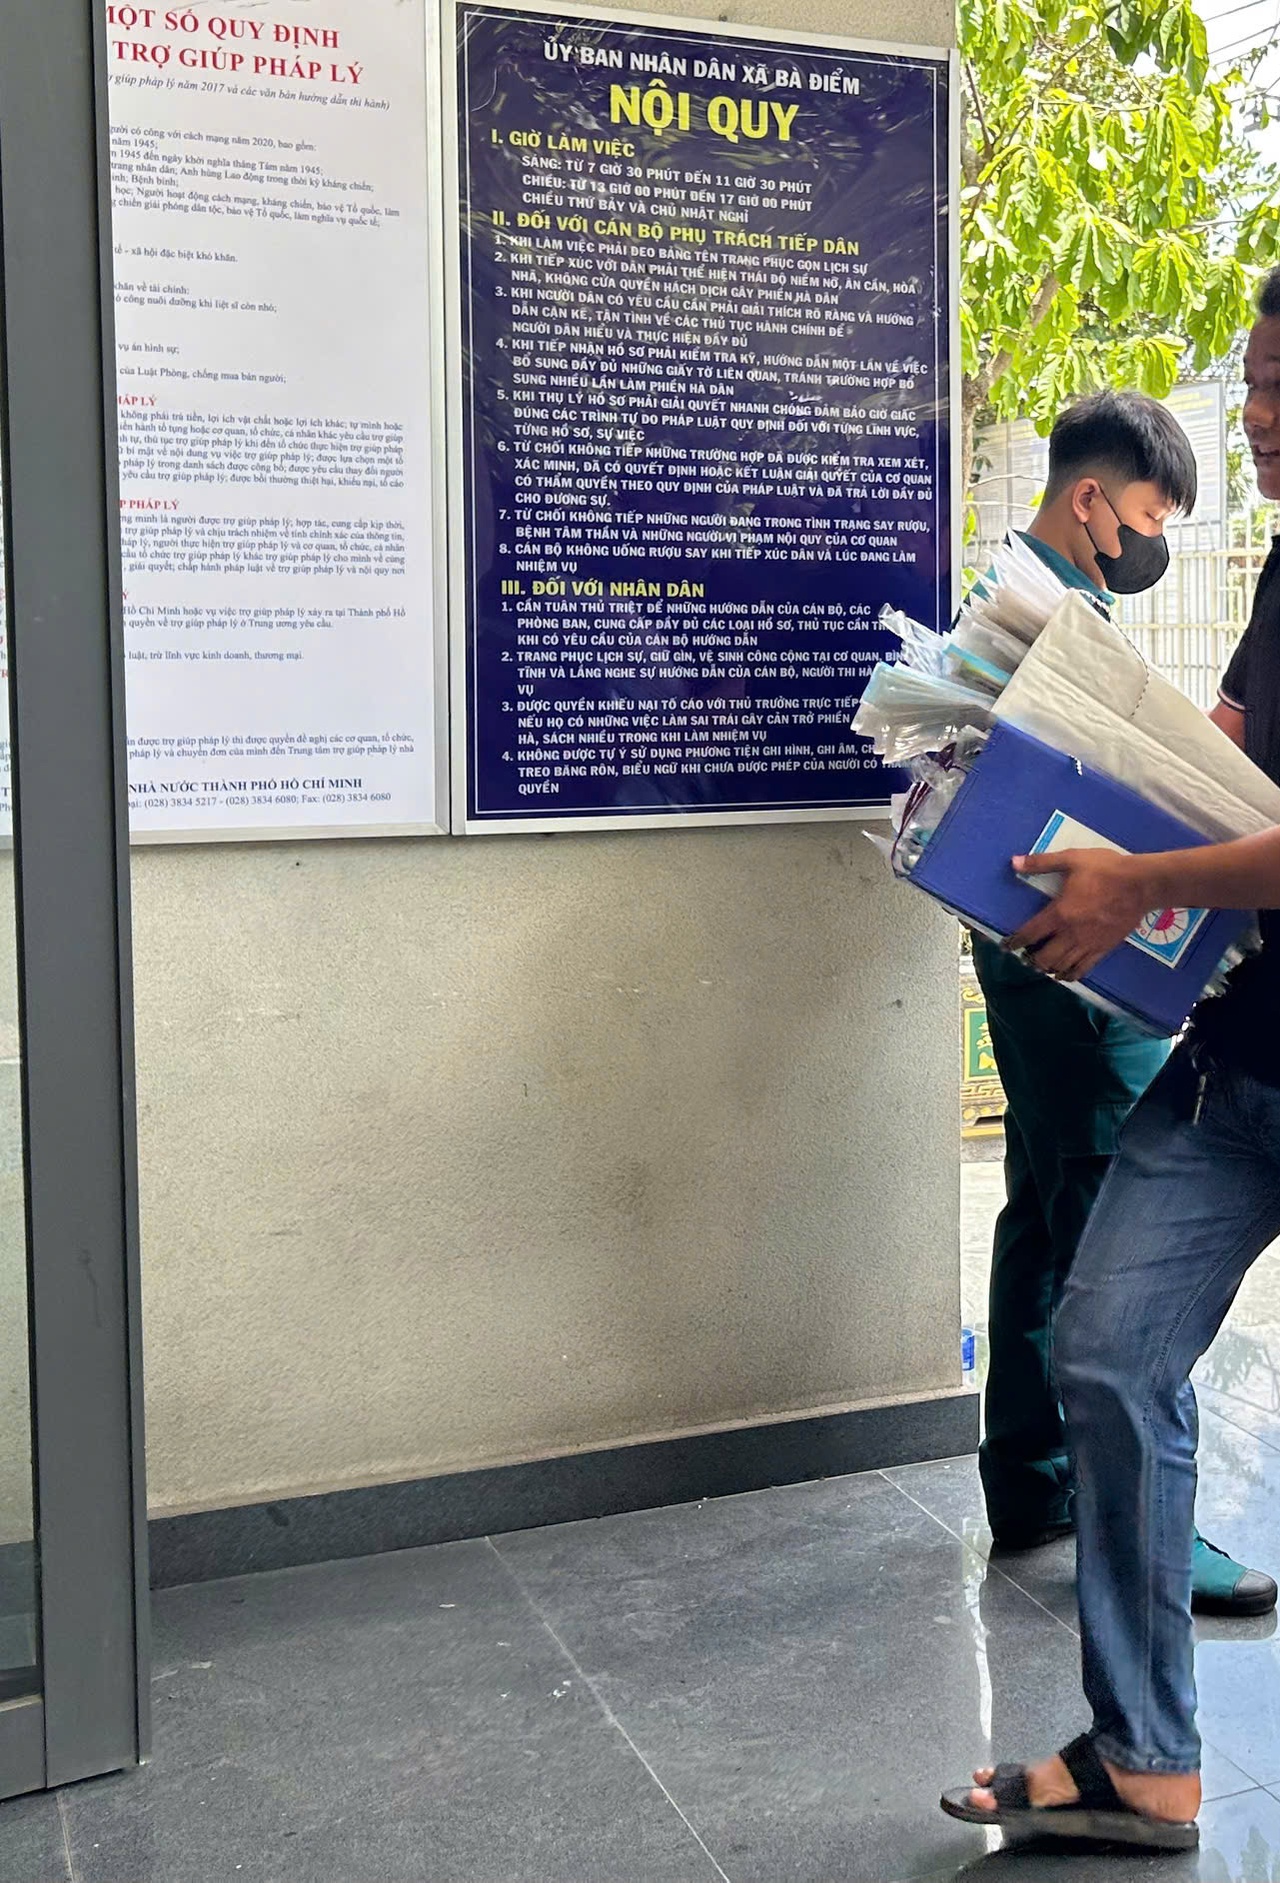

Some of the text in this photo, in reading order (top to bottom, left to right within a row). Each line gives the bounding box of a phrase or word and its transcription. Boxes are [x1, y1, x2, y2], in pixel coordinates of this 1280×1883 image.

[165, 9, 199, 33] SỐ
[208, 17, 264, 40] QUY
[274, 24, 339, 49] ĐỊNH
[112, 41, 364, 84] TRỢ GIÚP PHÁP LÝ
[544, 36, 860, 95] ỦY BAN NHÂN DÂN XÃ BÀ ĐIỂM
[610, 78, 800, 144] NỘI QUY
[491, 129, 635, 158] I. GIỜ LÀM VIỆC
[522, 155, 812, 194] SÁNG: TỪ 7 GIỜ 30 PHÚT ĐẾN 11 GIỜ 30 PHÚT
[570, 177, 587, 191] TỪ
[590, 181, 605, 192] 13
[609, 182, 631, 195] GIỜ
[635, 185, 650, 197] 00
[654, 186, 687, 201] PHÚT
[690, 188, 715, 203] ĐẾN
[720, 194, 734, 205] 17
[738, 194, 758, 207] GIỜ
[763, 197, 777, 209] 00
[781, 197, 812, 212] PHÚT
[568, 195, 595, 209] THỨ
[599, 198, 625, 212] BẢY
[630, 200, 645, 214] VÀ
[650, 203, 676, 217] CHỦ
[681, 206, 715, 220] NHẬT
[719, 208, 749, 223] NGHỈ
[492, 209, 859, 256] II. ĐỐI VỚI CÁN BỘ PHỤ TRÁCH TIẾP DÂN
[515, 492, 611, 507] CHO ĐƯƠNG SỰ.
[516, 560, 578, 574] NHIỆM VỤ
[501, 576, 704, 598] III. ĐỐI VỚI NHÂN DÂN
[501, 598, 871, 617] 1. CẦN TUÂN THỦ TRIỆT ĐỂ NHỮNG HƯỚNG DẪN CỦA CÁN BỘ, CÁC
[518, 631, 758, 647] KHI CÓ YÊU CẦU CỦA CÁN BỘ HƯỚNG DẪN
[518, 731, 539, 747] HÀ,
[543, 731, 575, 744] SÁCH
[618, 732, 658, 743] TRONG
[661, 732, 681, 743] KHI
[684, 730, 709, 742] LÀM
[712, 730, 749, 743] NHIỆM
[752, 731, 767, 743] VỤ
[129, 777, 362, 793] NHÀ NƯỚC THÀNH PHỐ HỒ CHÍ MINH
[518, 780, 559, 795] QUYỀN
[144, 798, 168, 808] (028)
[172, 798, 192, 807] 3834
[195, 797, 216, 806] 5217
[226, 796, 249, 806] (028)
[252, 796, 272, 805] 3834
[275, 795, 299, 804] 6080;
[302, 794, 320, 803] Fax:
[323, 793, 345, 804] (028)
[347, 793, 368, 802] 3834
[370, 793, 391, 802] 6080
